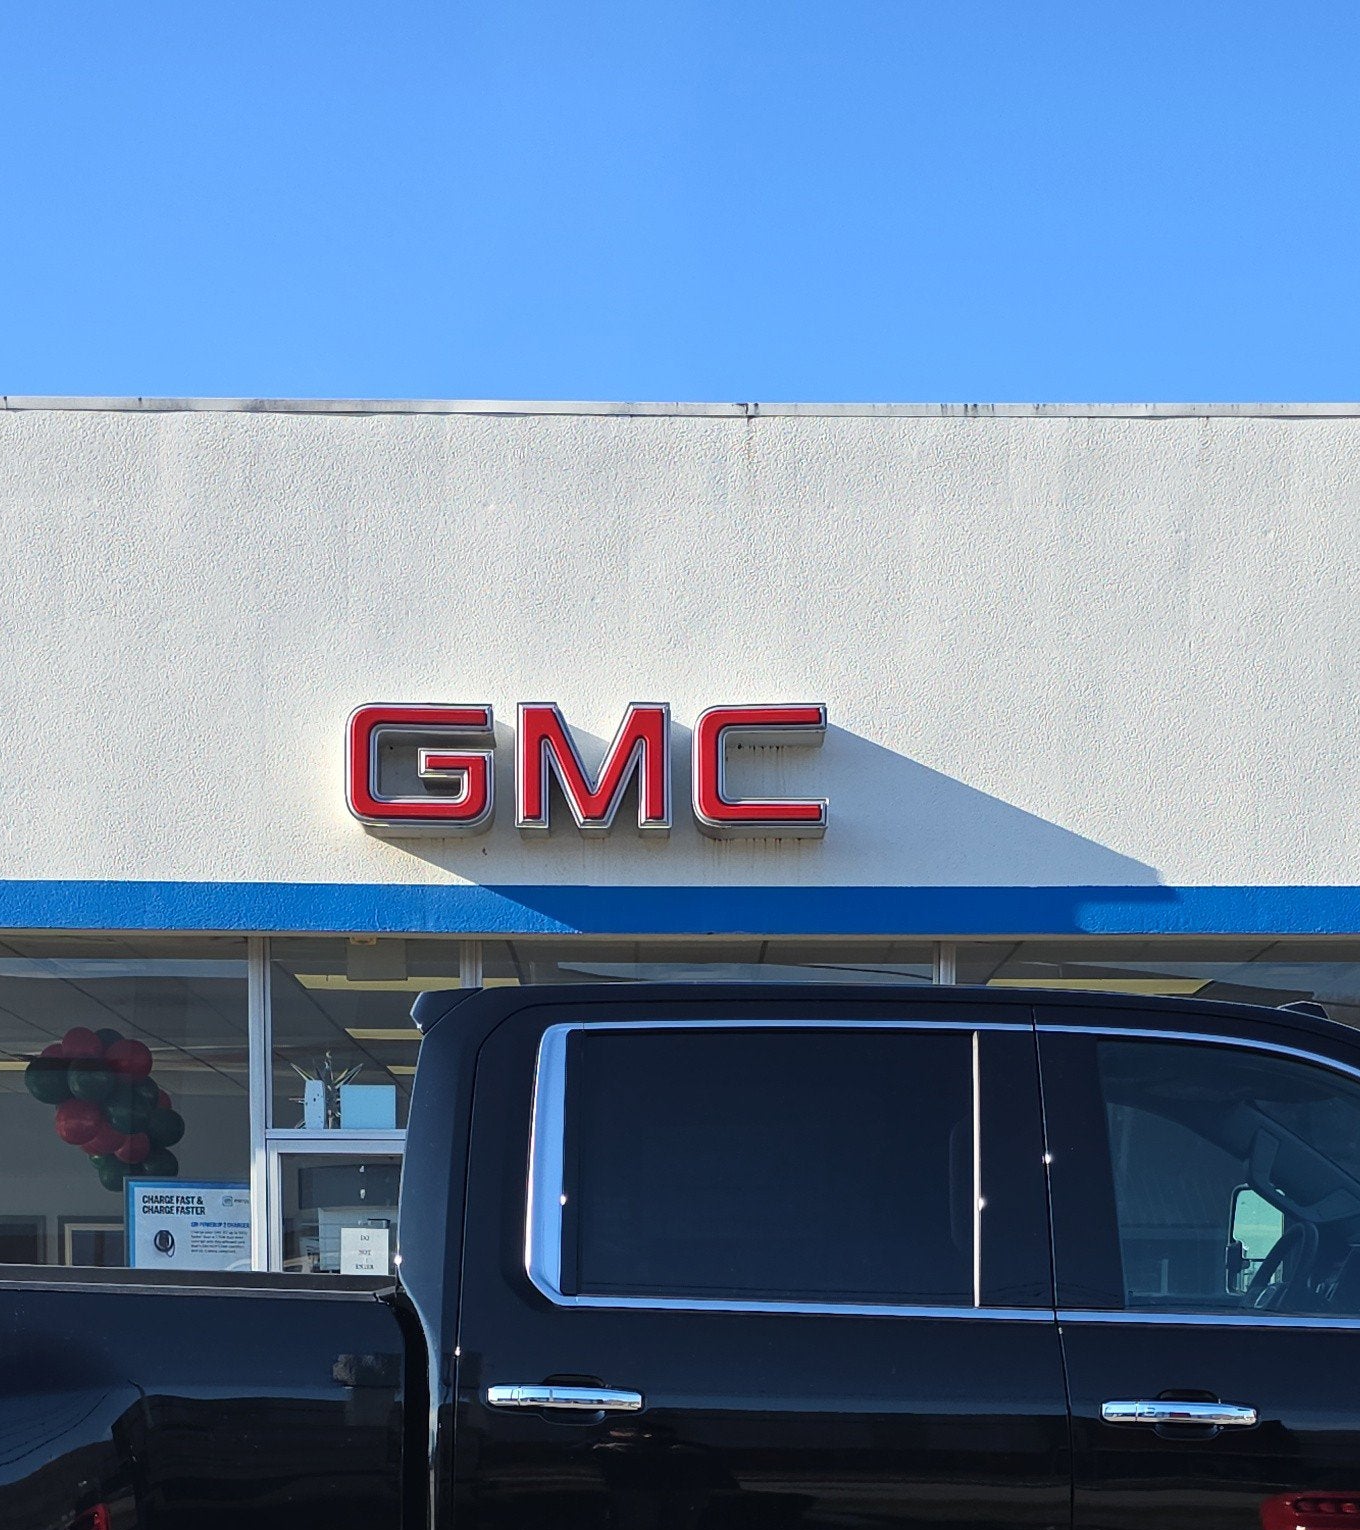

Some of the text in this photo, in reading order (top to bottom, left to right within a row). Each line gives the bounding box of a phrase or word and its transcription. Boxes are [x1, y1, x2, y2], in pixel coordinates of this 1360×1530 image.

[345, 702, 829, 832] GMC
[142, 1195, 204, 1205] CHARGE FAST &
[142, 1205, 206, 1216] CHARGE FASTER
